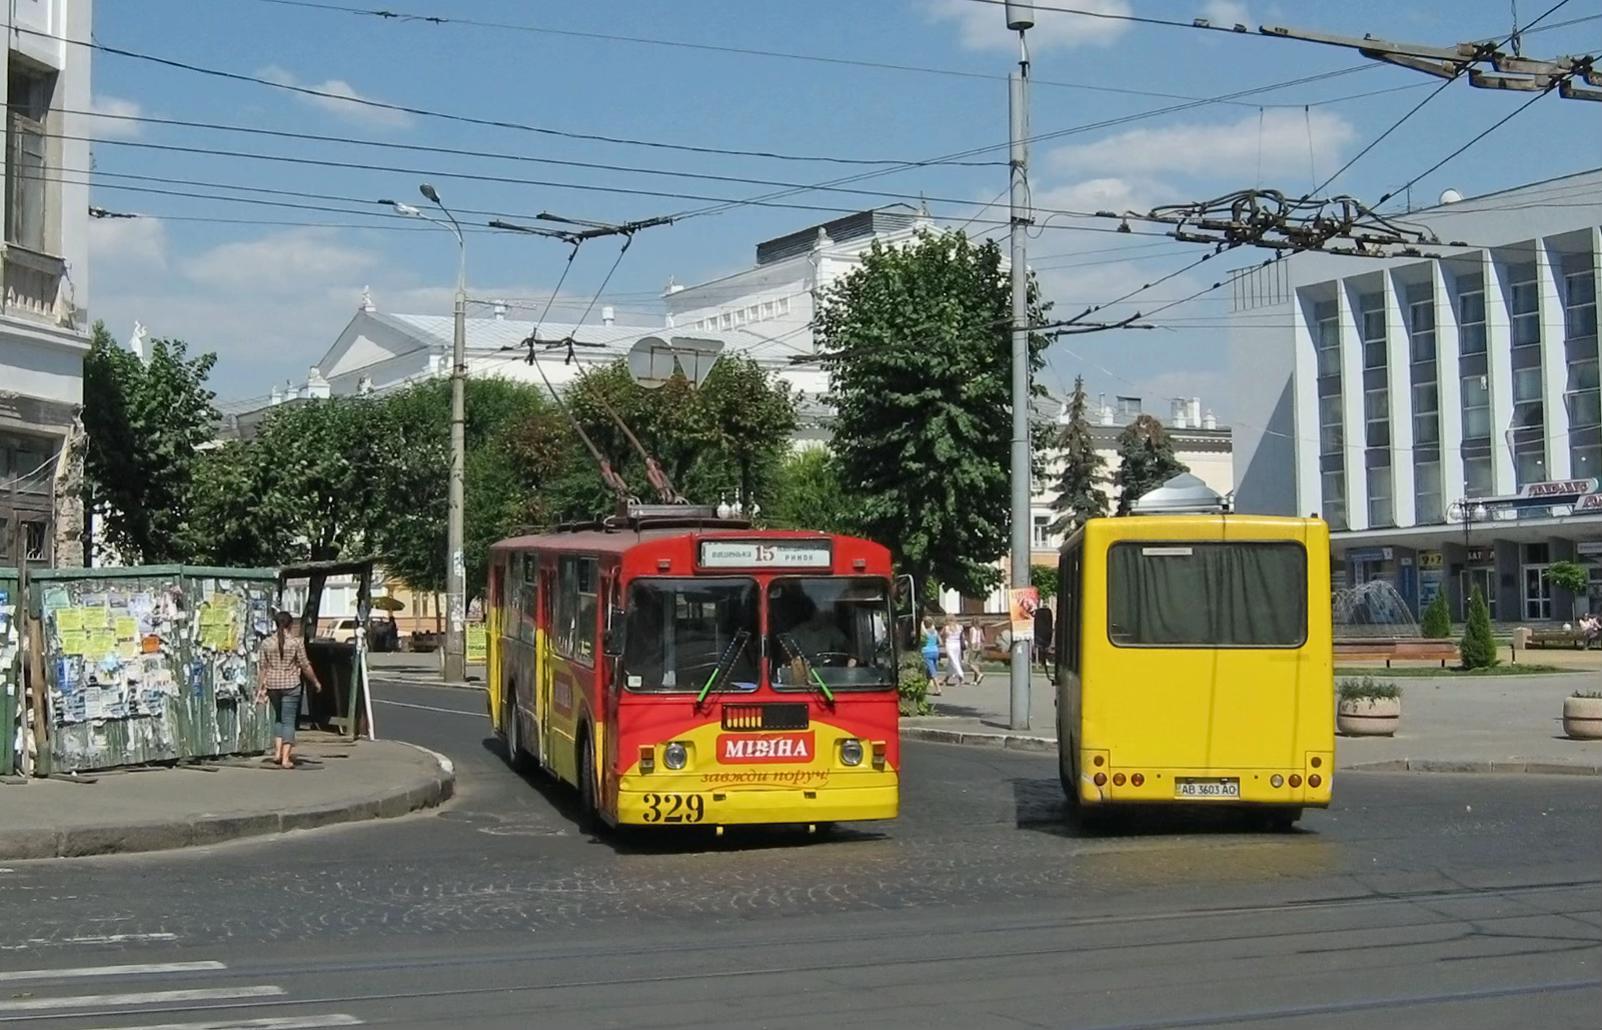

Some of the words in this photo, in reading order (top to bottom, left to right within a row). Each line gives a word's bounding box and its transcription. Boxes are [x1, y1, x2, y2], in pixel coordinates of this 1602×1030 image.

[755, 546, 775, 562] 15
[700, 768, 768, 783] завжди
[1199, 784, 1219, 794] 3603
[642, 793, 705, 823] 329
